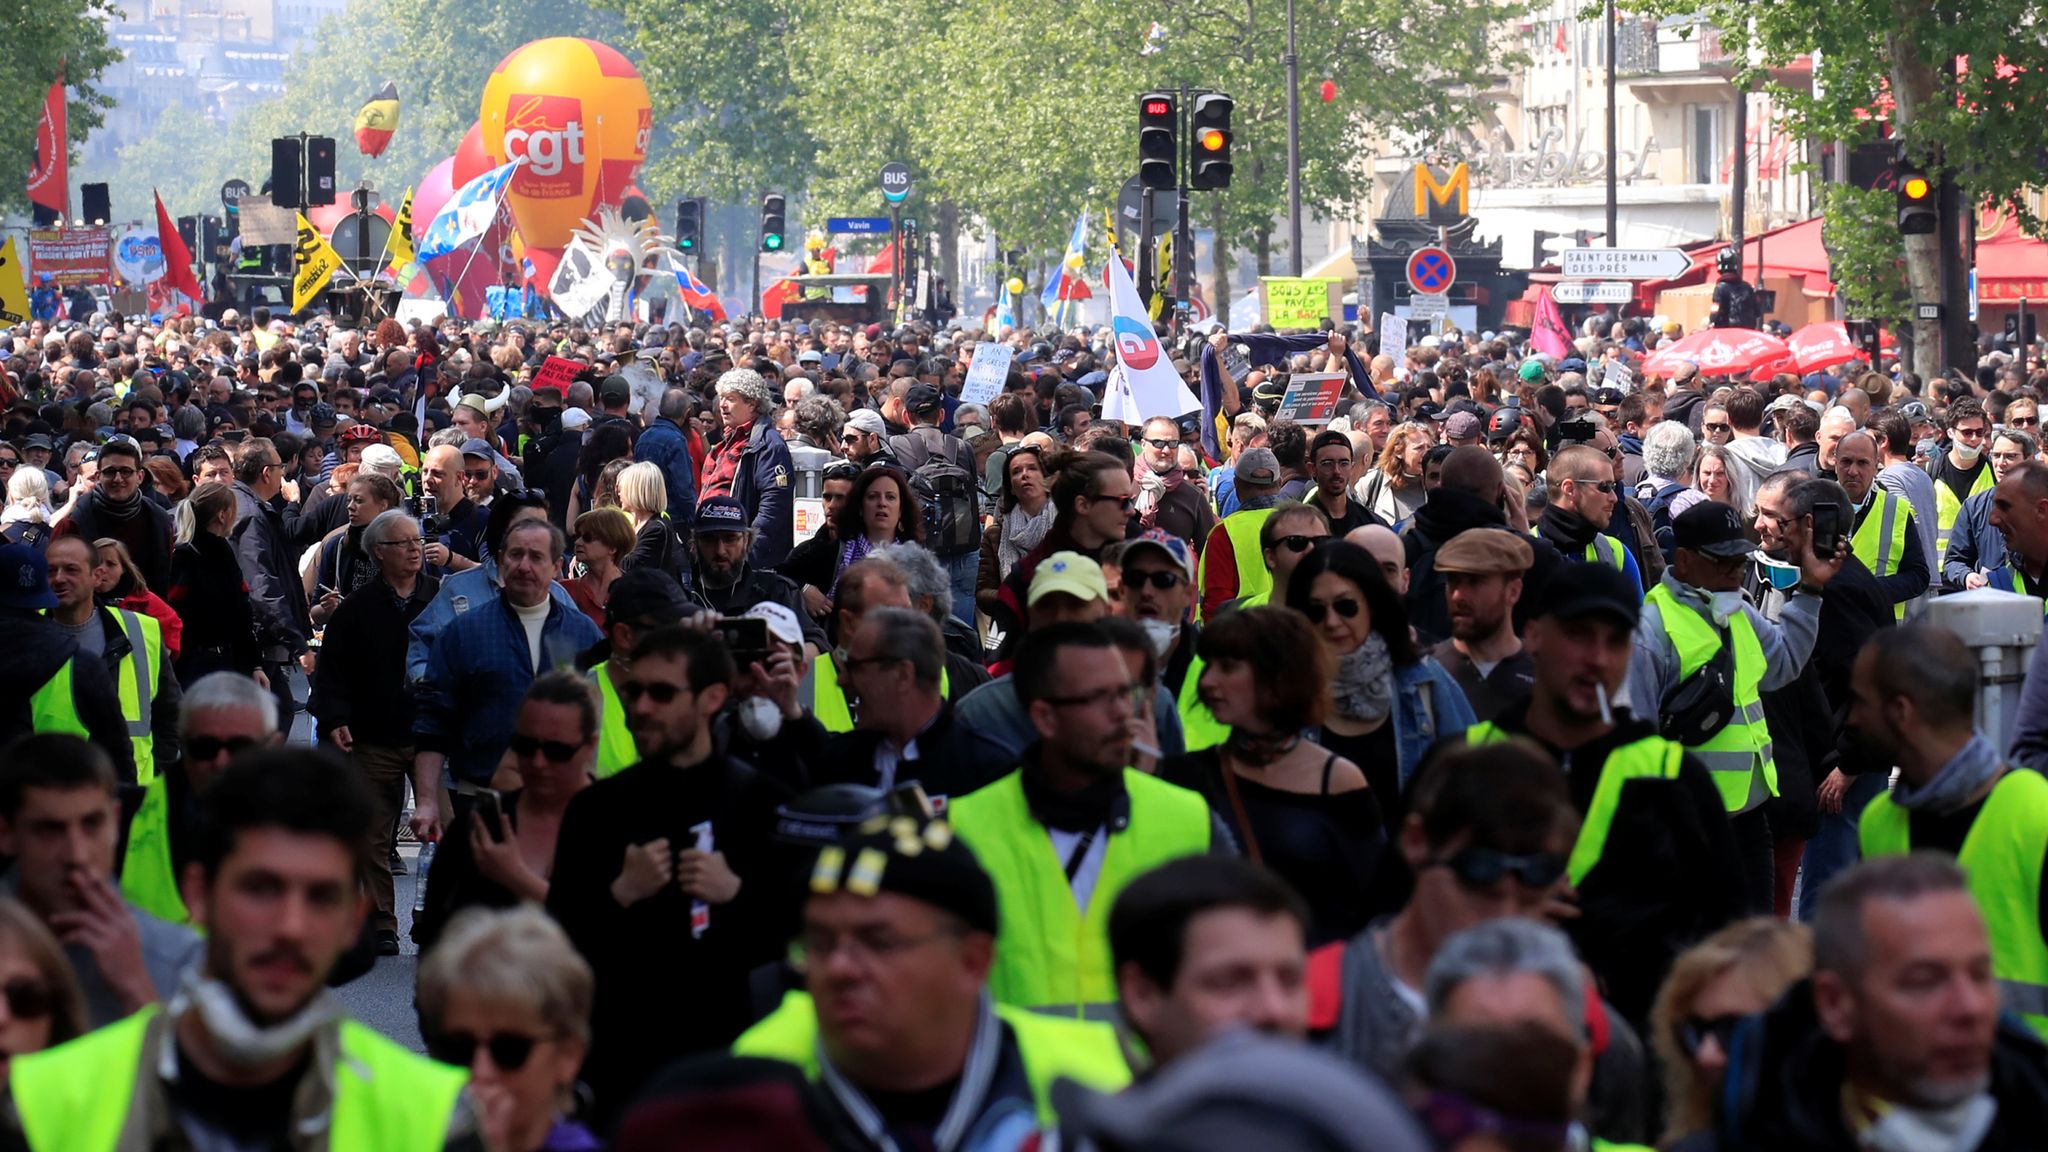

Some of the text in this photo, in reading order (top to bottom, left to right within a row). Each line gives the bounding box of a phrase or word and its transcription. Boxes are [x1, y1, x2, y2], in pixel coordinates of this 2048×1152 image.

[505, 96, 568, 131] la
[1147, 103, 1166, 114] BUS
[504, 121, 584, 176] cgt
[884, 172, 907, 185] BUS
[225, 186, 247, 198] BUS
[1414, 162, 1468, 216] M
[848, 221, 870, 229] Vavin
[1568, 253, 1658, 262] SAINT GERMAIN
[1271, 284, 1326, 296] SOUS LES
[1563, 287, 1627, 298] MONTPARNASSE
[1275, 310, 1289, 320] LA
